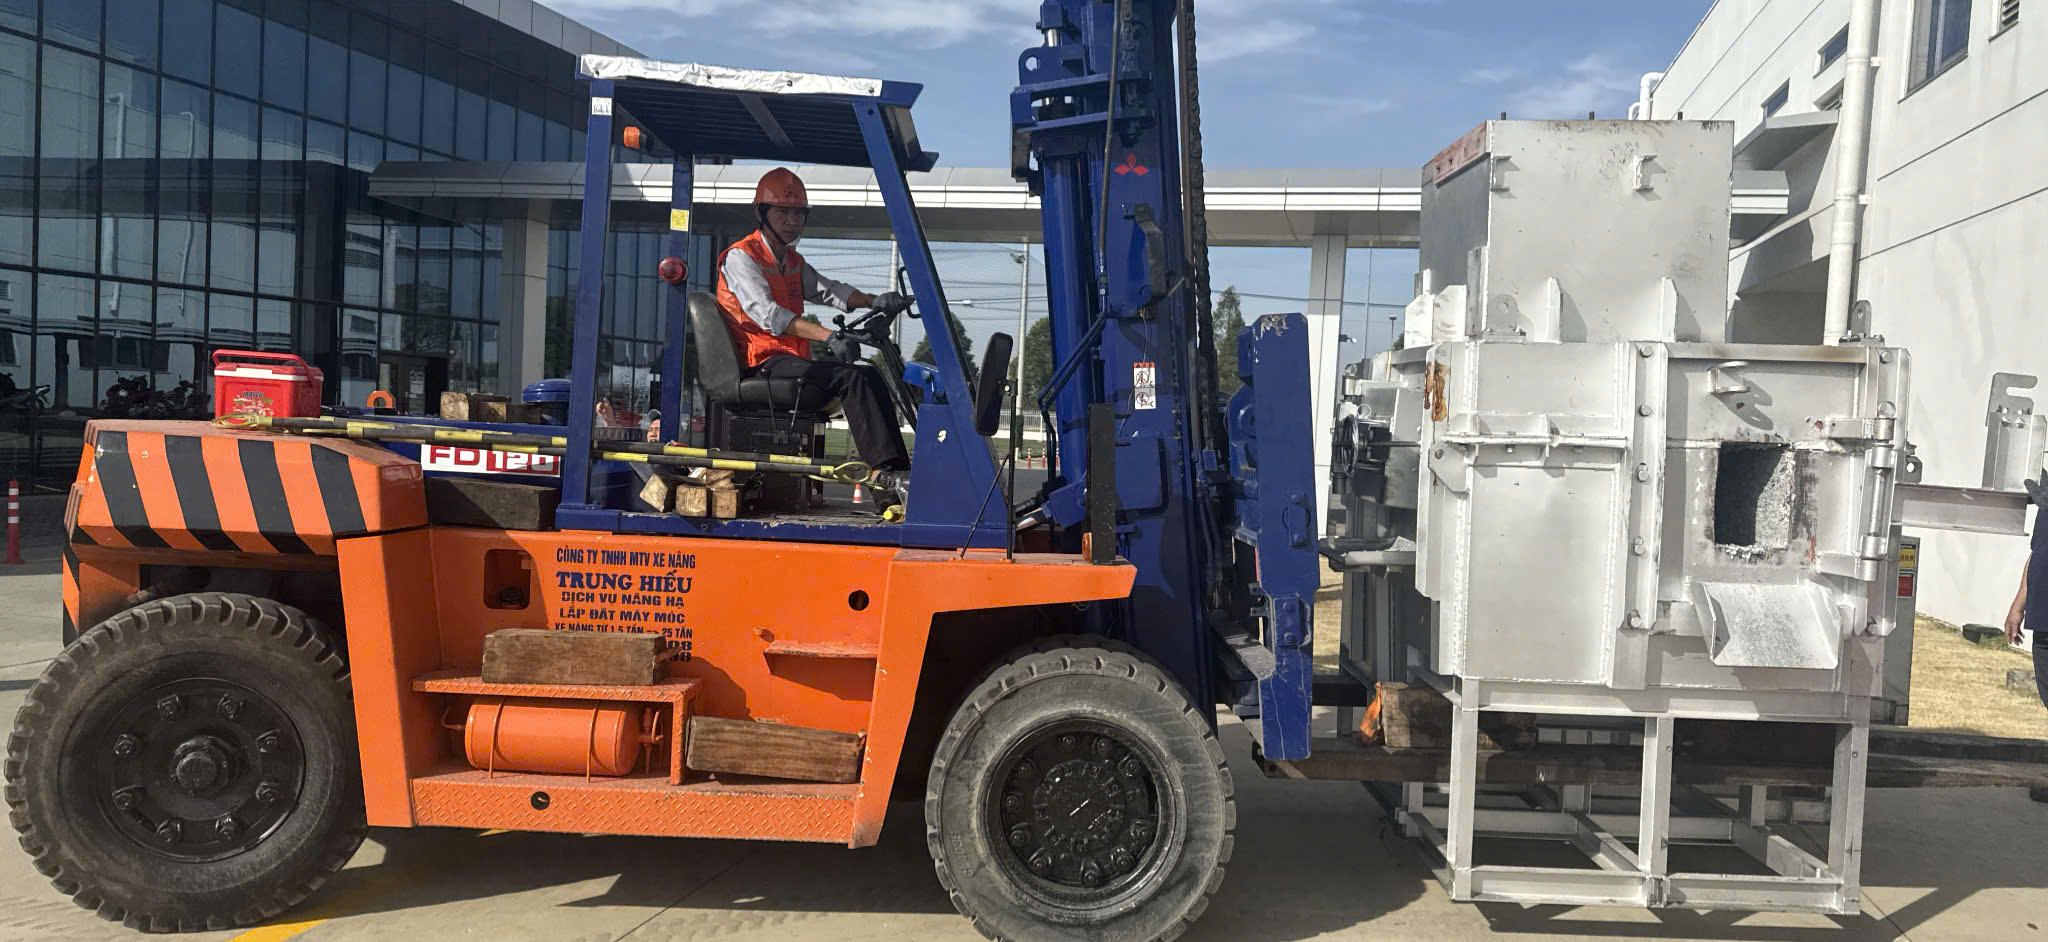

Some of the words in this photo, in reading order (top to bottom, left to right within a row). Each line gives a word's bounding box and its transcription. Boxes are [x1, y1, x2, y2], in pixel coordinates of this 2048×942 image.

[430, 445, 480, 465] FD
[491, 451, 553, 472] 120
[556, 545, 584, 564] CÔNG
[587, 549, 598, 564] TY
[601, 550, 627, 566] TNHH
[630, 551, 650, 567] MTV
[653, 553, 665, 568] XE
[668, 551, 696, 569] NÂNG
[556, 571, 633, 591] TRUNG
[639, 569, 693, 593] HIẾU
[561, 591, 595, 604] DỊCH
[621, 592, 661, 606] NÂNG
[665, 596, 685, 609] HẠ
[620, 608, 650, 622] MÁY
[654, 611, 685, 624] MÓC
[661, 627, 673, 638] 25
